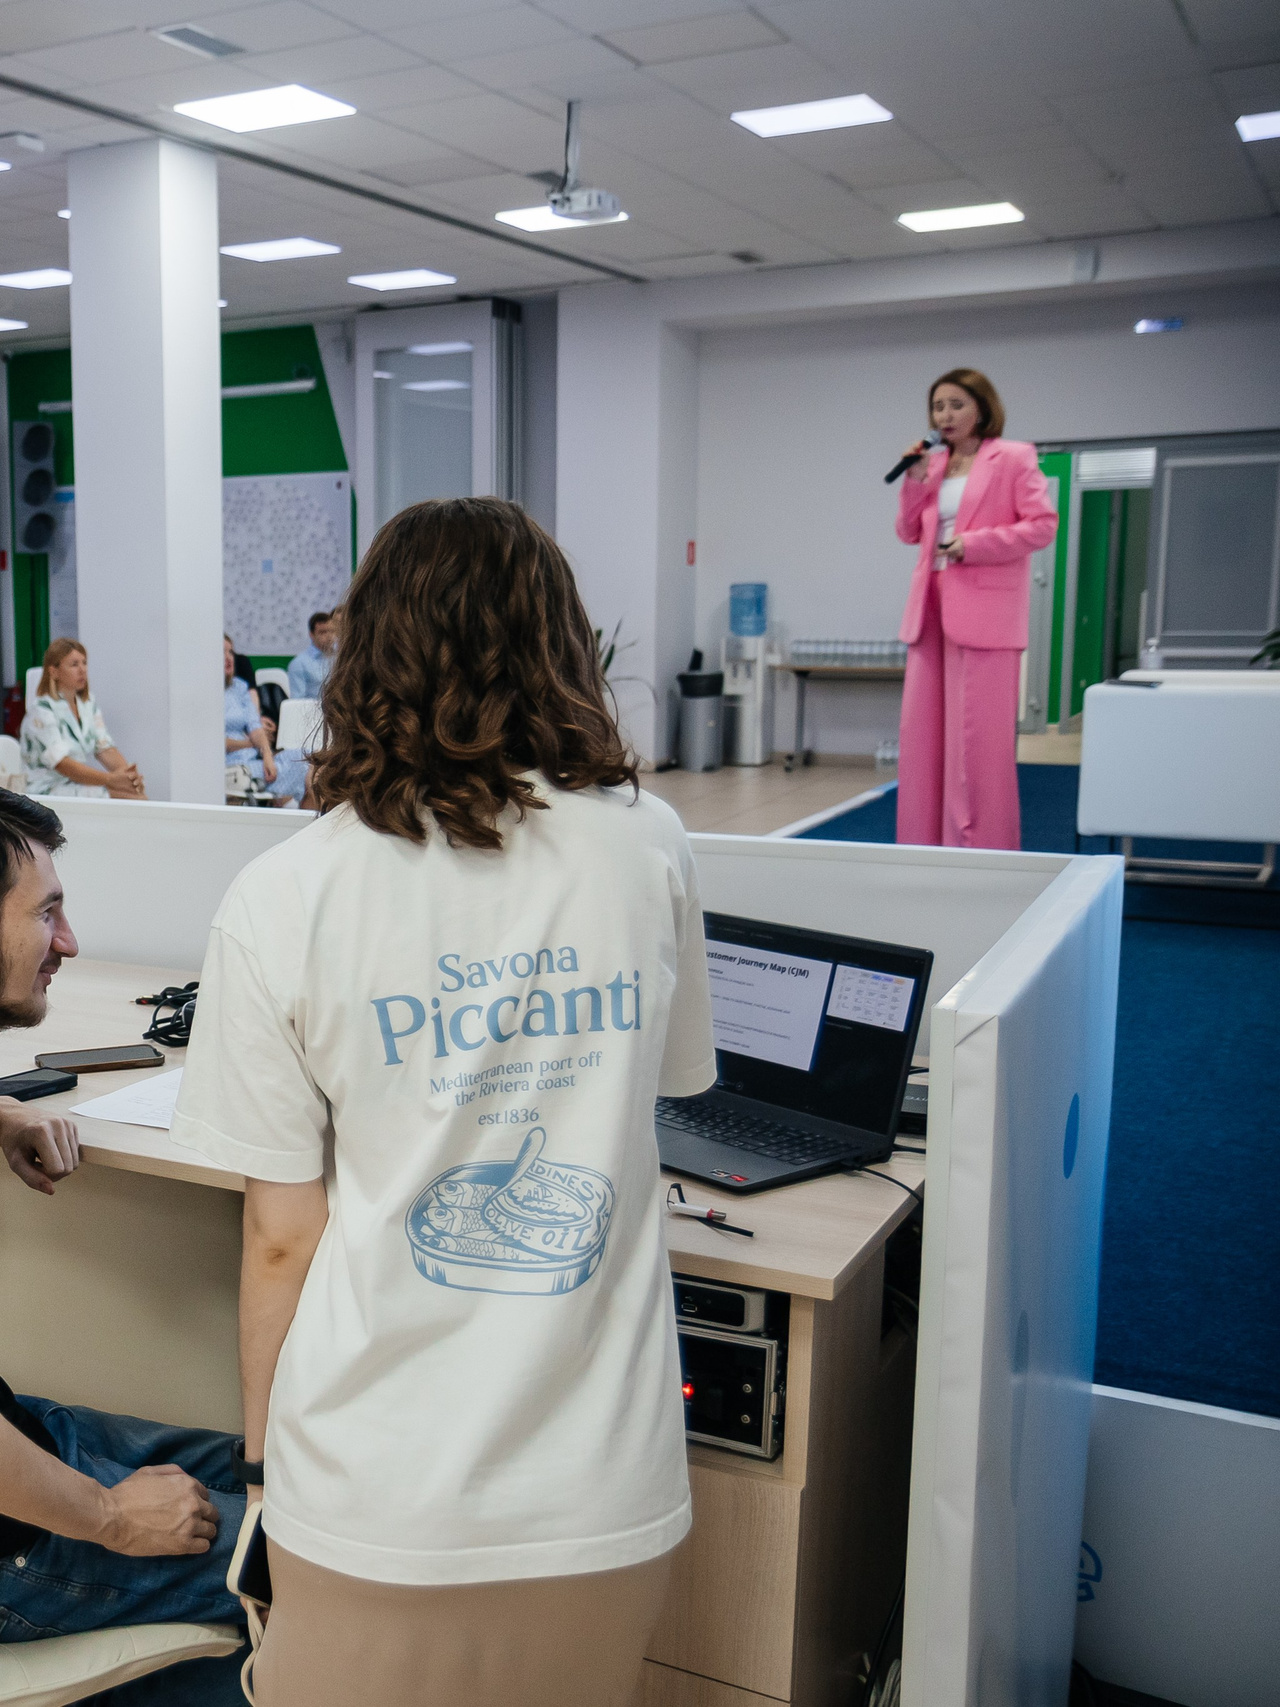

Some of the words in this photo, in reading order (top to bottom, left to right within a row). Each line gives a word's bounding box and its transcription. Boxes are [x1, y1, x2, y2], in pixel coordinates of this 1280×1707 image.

[437, 946, 579, 993] Savona
[706, 951, 737, 963] ustomer
[737, 956, 768, 971] Journey
[769, 962, 787, 975] Map
[787, 966, 810, 979] (CJM)
[370, 969, 641, 1066] Piccanti
[429, 1061, 534, 1095] Mediterranean
[539, 1057, 574, 1077] port
[578, 1050, 603, 1068] off
[455, 1090, 476, 1107] the
[479, 1080, 530, 1099] Riviera
[536, 1073, 576, 1091] coast
[486, 1207, 534, 1240] OLIVE
